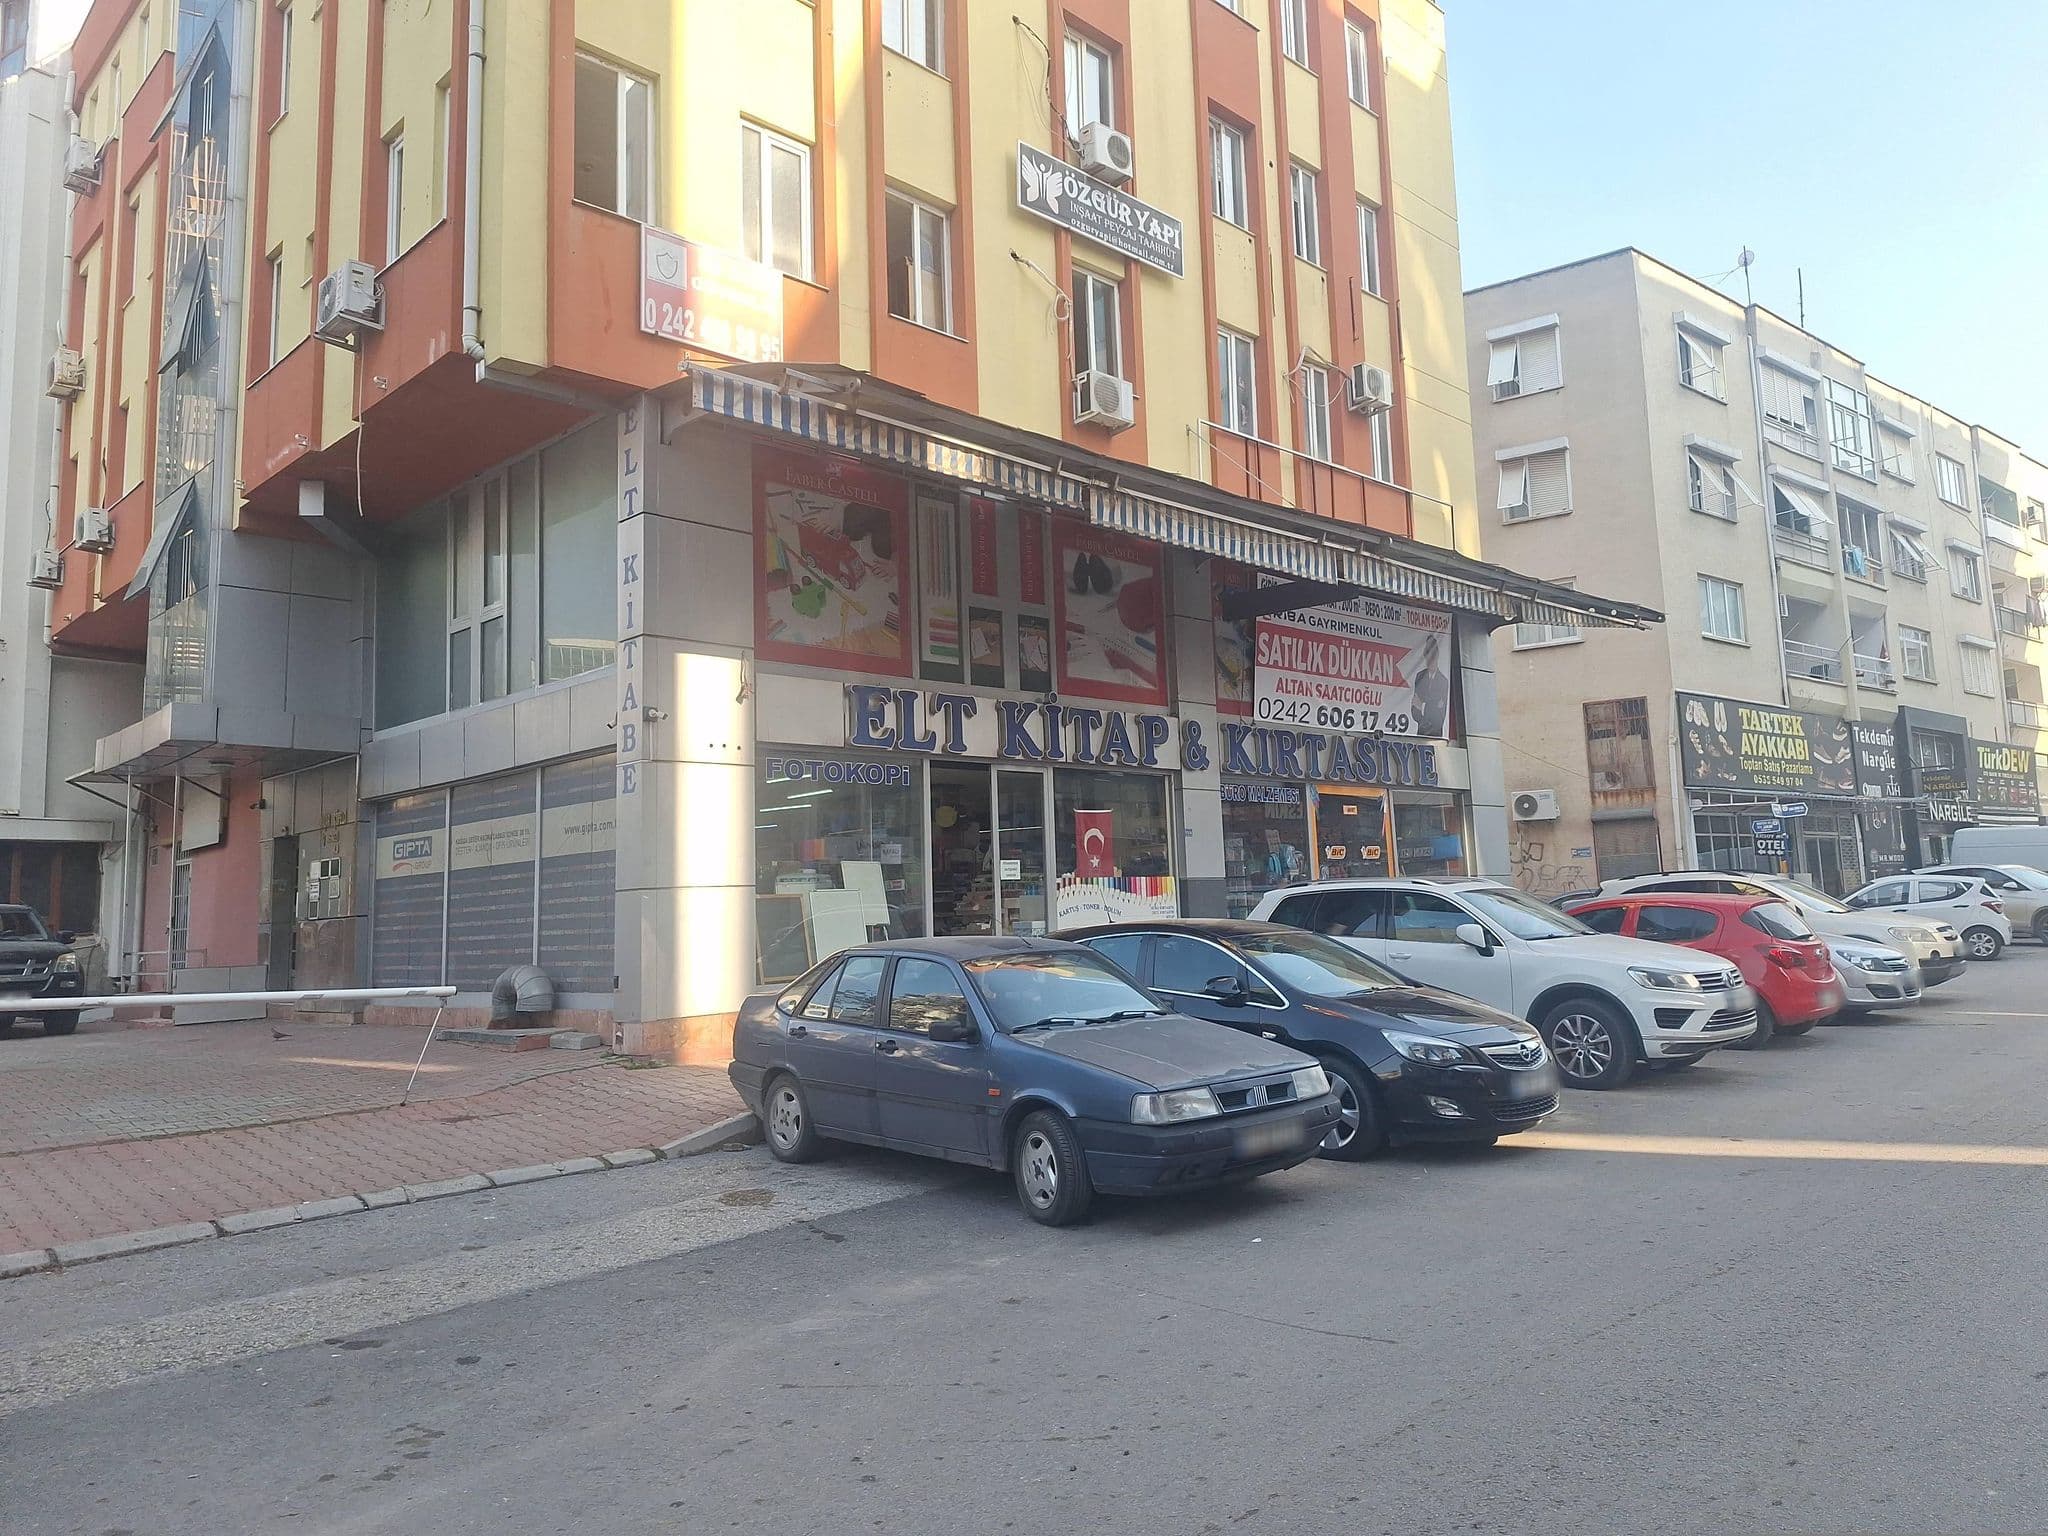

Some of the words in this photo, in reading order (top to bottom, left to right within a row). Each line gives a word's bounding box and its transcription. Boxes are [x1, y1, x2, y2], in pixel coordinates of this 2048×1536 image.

[1063, 170, 1133, 227] ÖZGÜR
[1134, 209, 1181, 249] YAPI
[1104, 219, 1137, 241] PEYZAJ
[645, 298, 657, 328] 0
[661, 303, 695, 339] 242
[623, 407, 638, 516] ELT
[1258, 633, 1325, 675] SATILIK
[1329, 640, 1393, 684] DÜKKAN
[1276, 677, 1313, 698] ALTAN
[848, 684, 978, 755] ELT
[999, 692, 1170, 768] KİTAP
[1181, 720, 1210, 771] &
[1258, 697, 1311, 724] 0242
[1316, 707, 1355, 730] 606
[1360, 711, 1379, 731] 17
[1385, 713, 1409, 733] 49
[1739, 708, 1805, 737] TARTEK
[1741, 732, 1810, 760] AYAKKABI
[1853, 726, 1895, 747] Tekdemir
[1739, 757, 1763, 772] Toptan
[1781, 760, 1814, 775] Pazarlama
[1862, 750, 1896, 771] Nargile
[394, 839, 432, 858] GIPTA
[1756, 839, 1786, 850] OTEL
